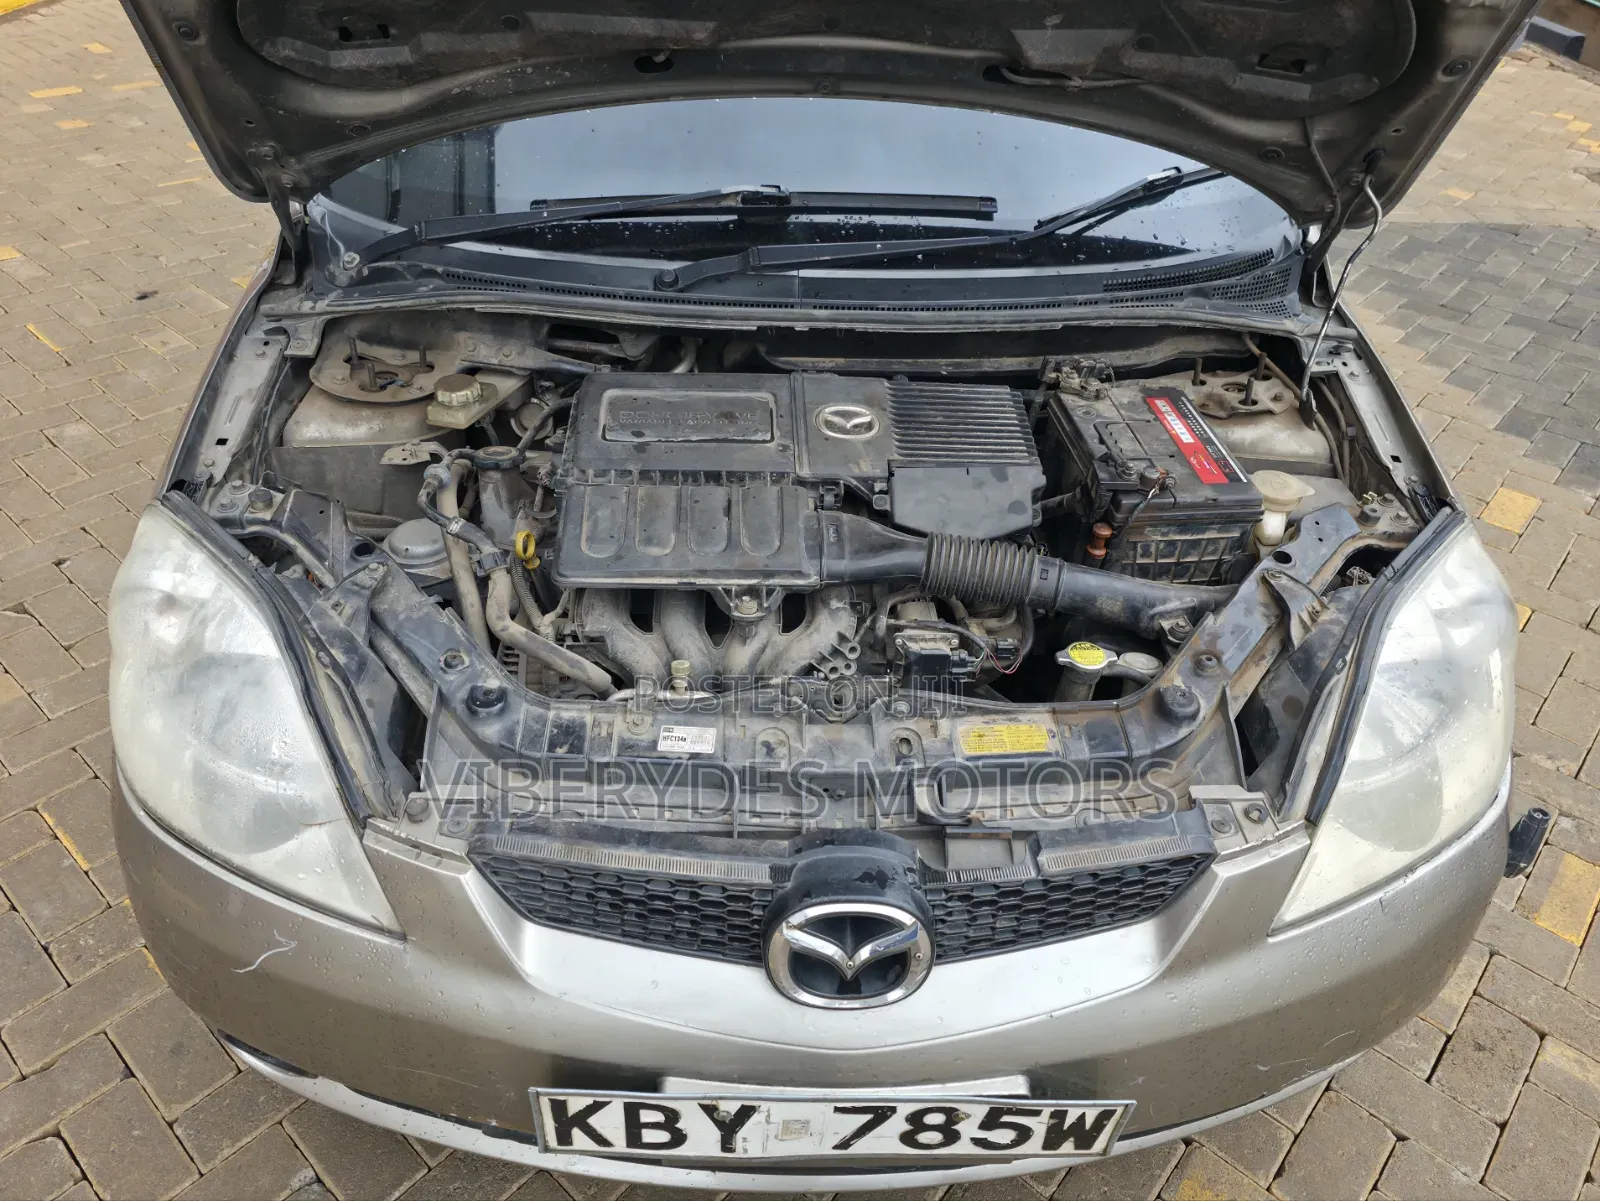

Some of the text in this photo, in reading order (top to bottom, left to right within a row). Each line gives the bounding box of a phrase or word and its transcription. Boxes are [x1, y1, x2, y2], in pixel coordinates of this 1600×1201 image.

[684, 411, 760, 420] 16-VVE
[547, 1098, 1117, 1154] KBY 785W
